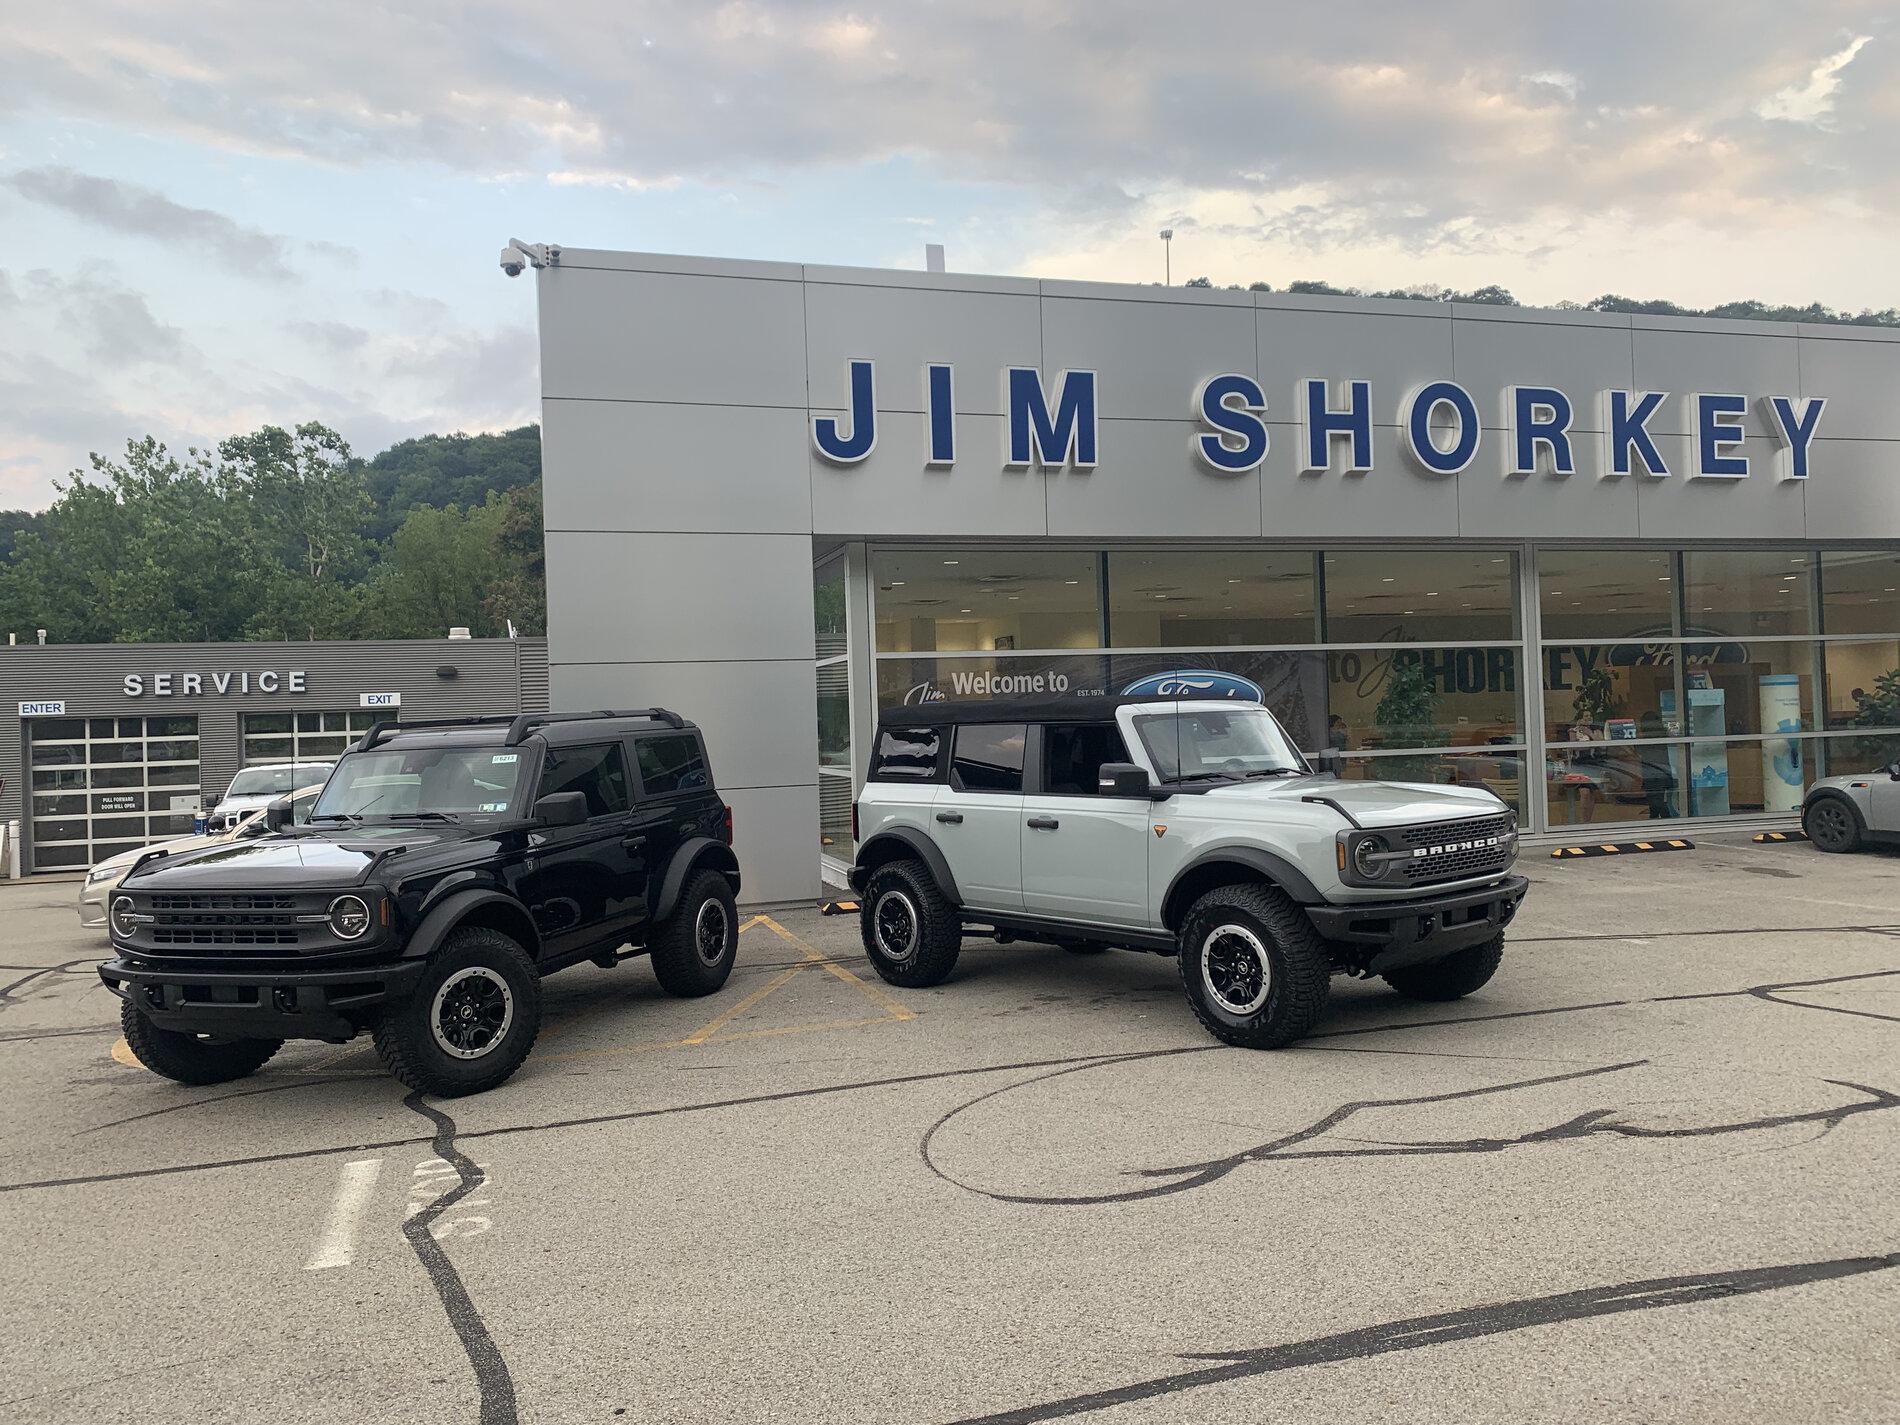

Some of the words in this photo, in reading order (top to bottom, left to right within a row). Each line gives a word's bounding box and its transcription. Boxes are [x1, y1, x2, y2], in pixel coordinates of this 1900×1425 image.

[809, 358, 1099, 468] JIM
[1190, 371, 1828, 482] SHORKEY
[123, 671, 306, 697] SERVICE
[951, 670, 1044, 695] Welcome
[1048, 671, 1069, 693] to
[22, 702, 62, 714] ENTER
[367, 694, 393, 705] EXIT
[1413, 837, 1498, 857] BRONCO
